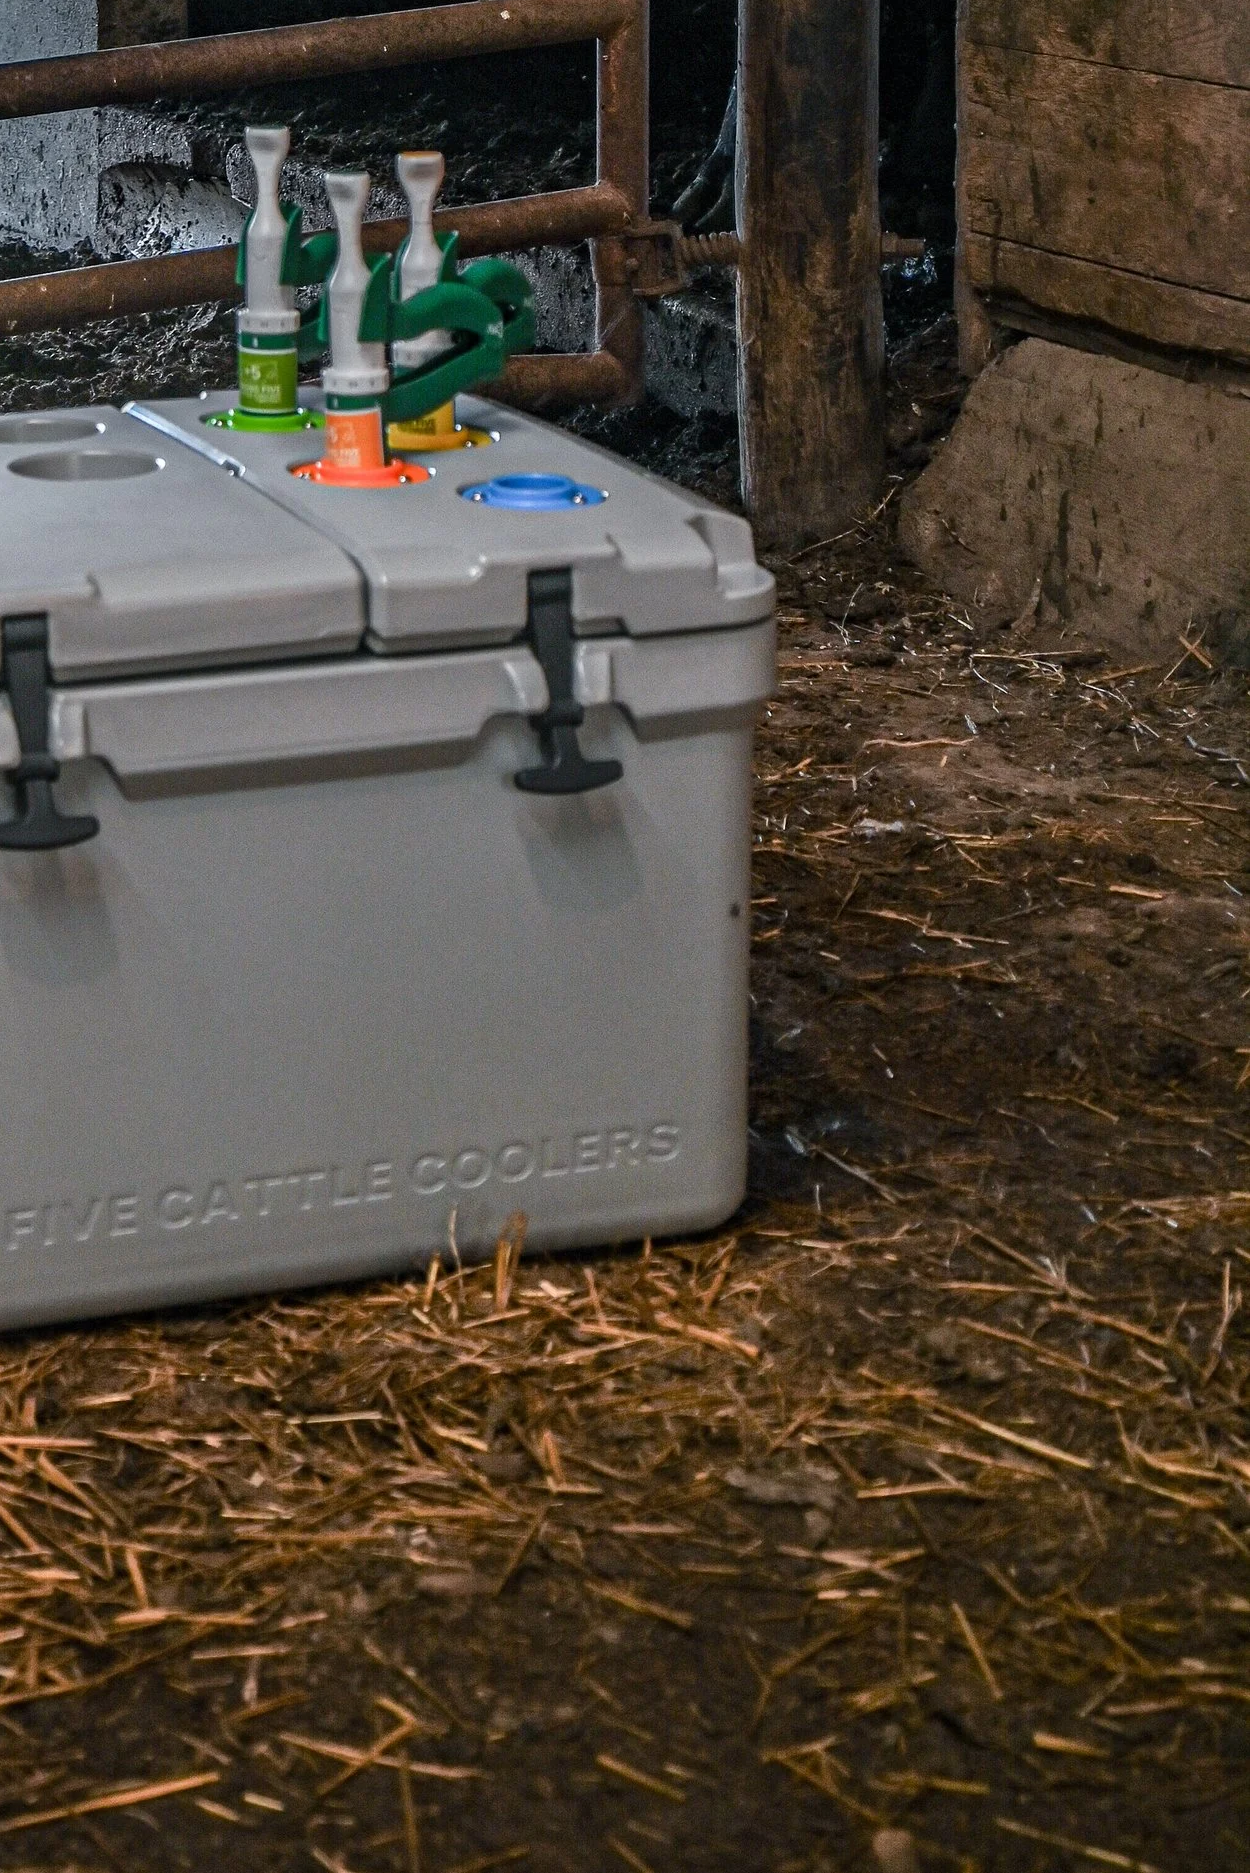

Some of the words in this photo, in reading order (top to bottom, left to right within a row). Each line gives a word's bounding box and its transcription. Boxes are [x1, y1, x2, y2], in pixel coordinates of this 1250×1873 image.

[3, 1195, 142, 1252] FIVE
[154, 1160, 395, 1230] CATTLE
[408, 1122, 683, 1195] COOLERS
